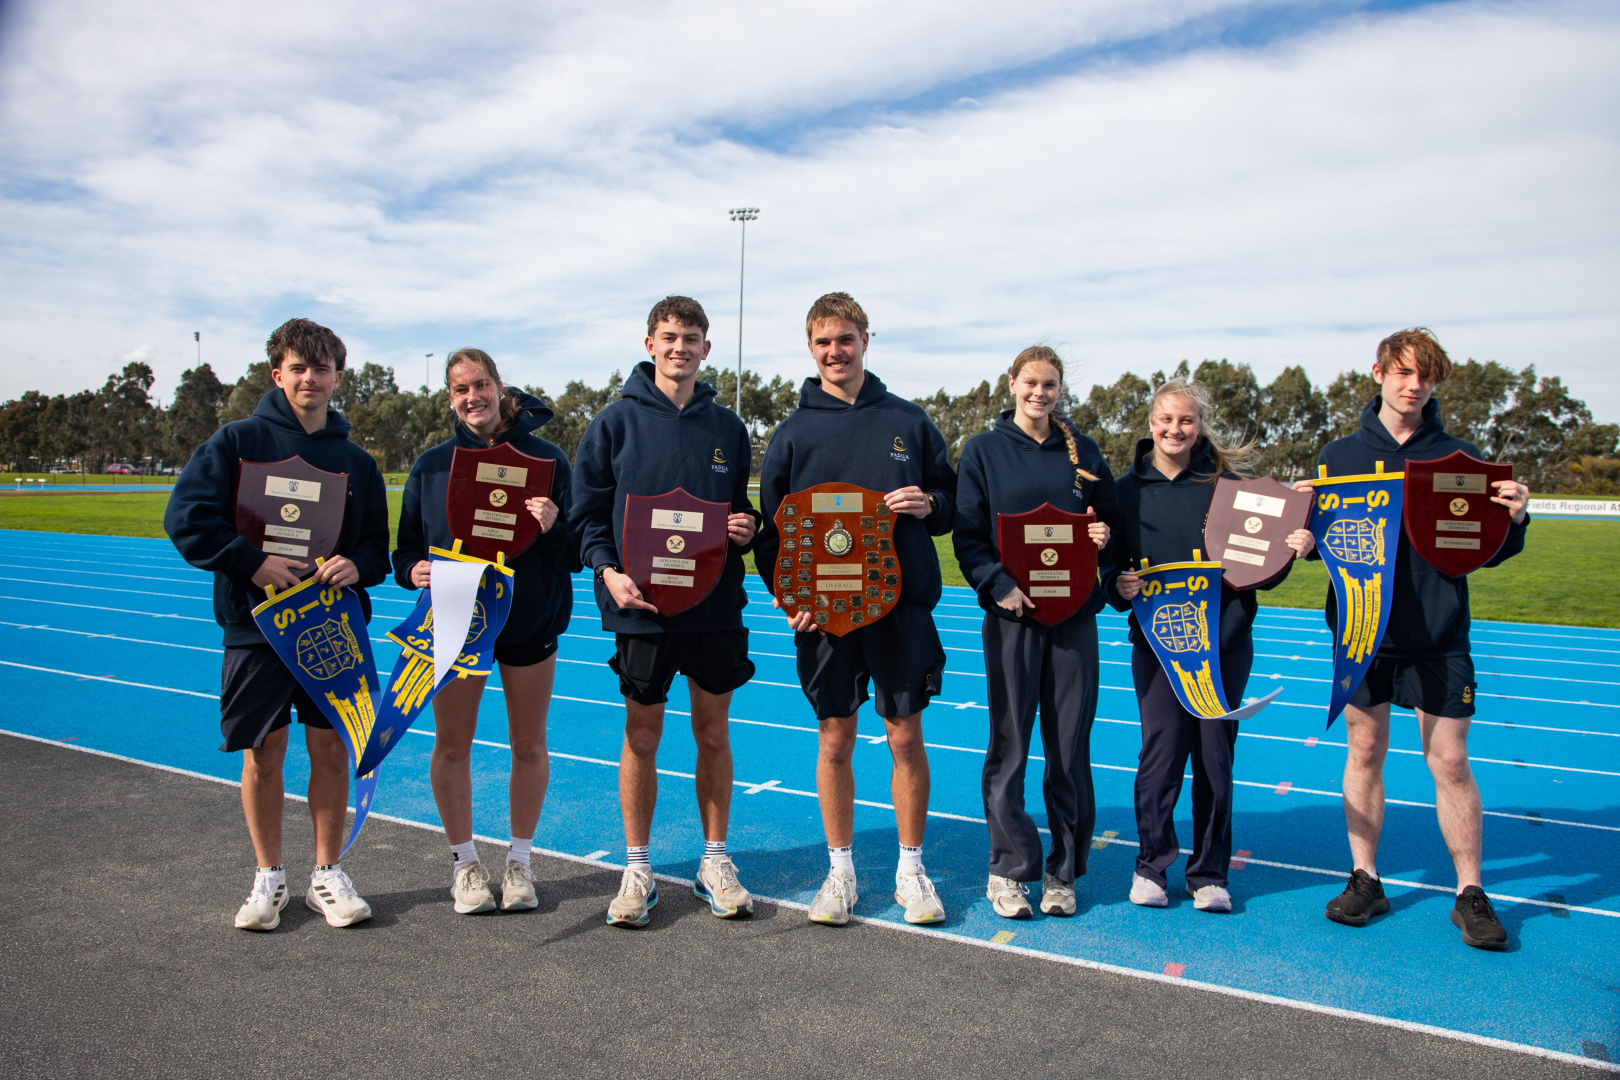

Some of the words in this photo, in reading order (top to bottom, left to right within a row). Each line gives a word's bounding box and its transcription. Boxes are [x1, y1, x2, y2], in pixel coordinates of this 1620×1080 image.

[1560, 502, 1606, 512] Regional
[1361, 618, 1370, 644] CARNIVAL
[350, 710, 361, 732] WINNER
